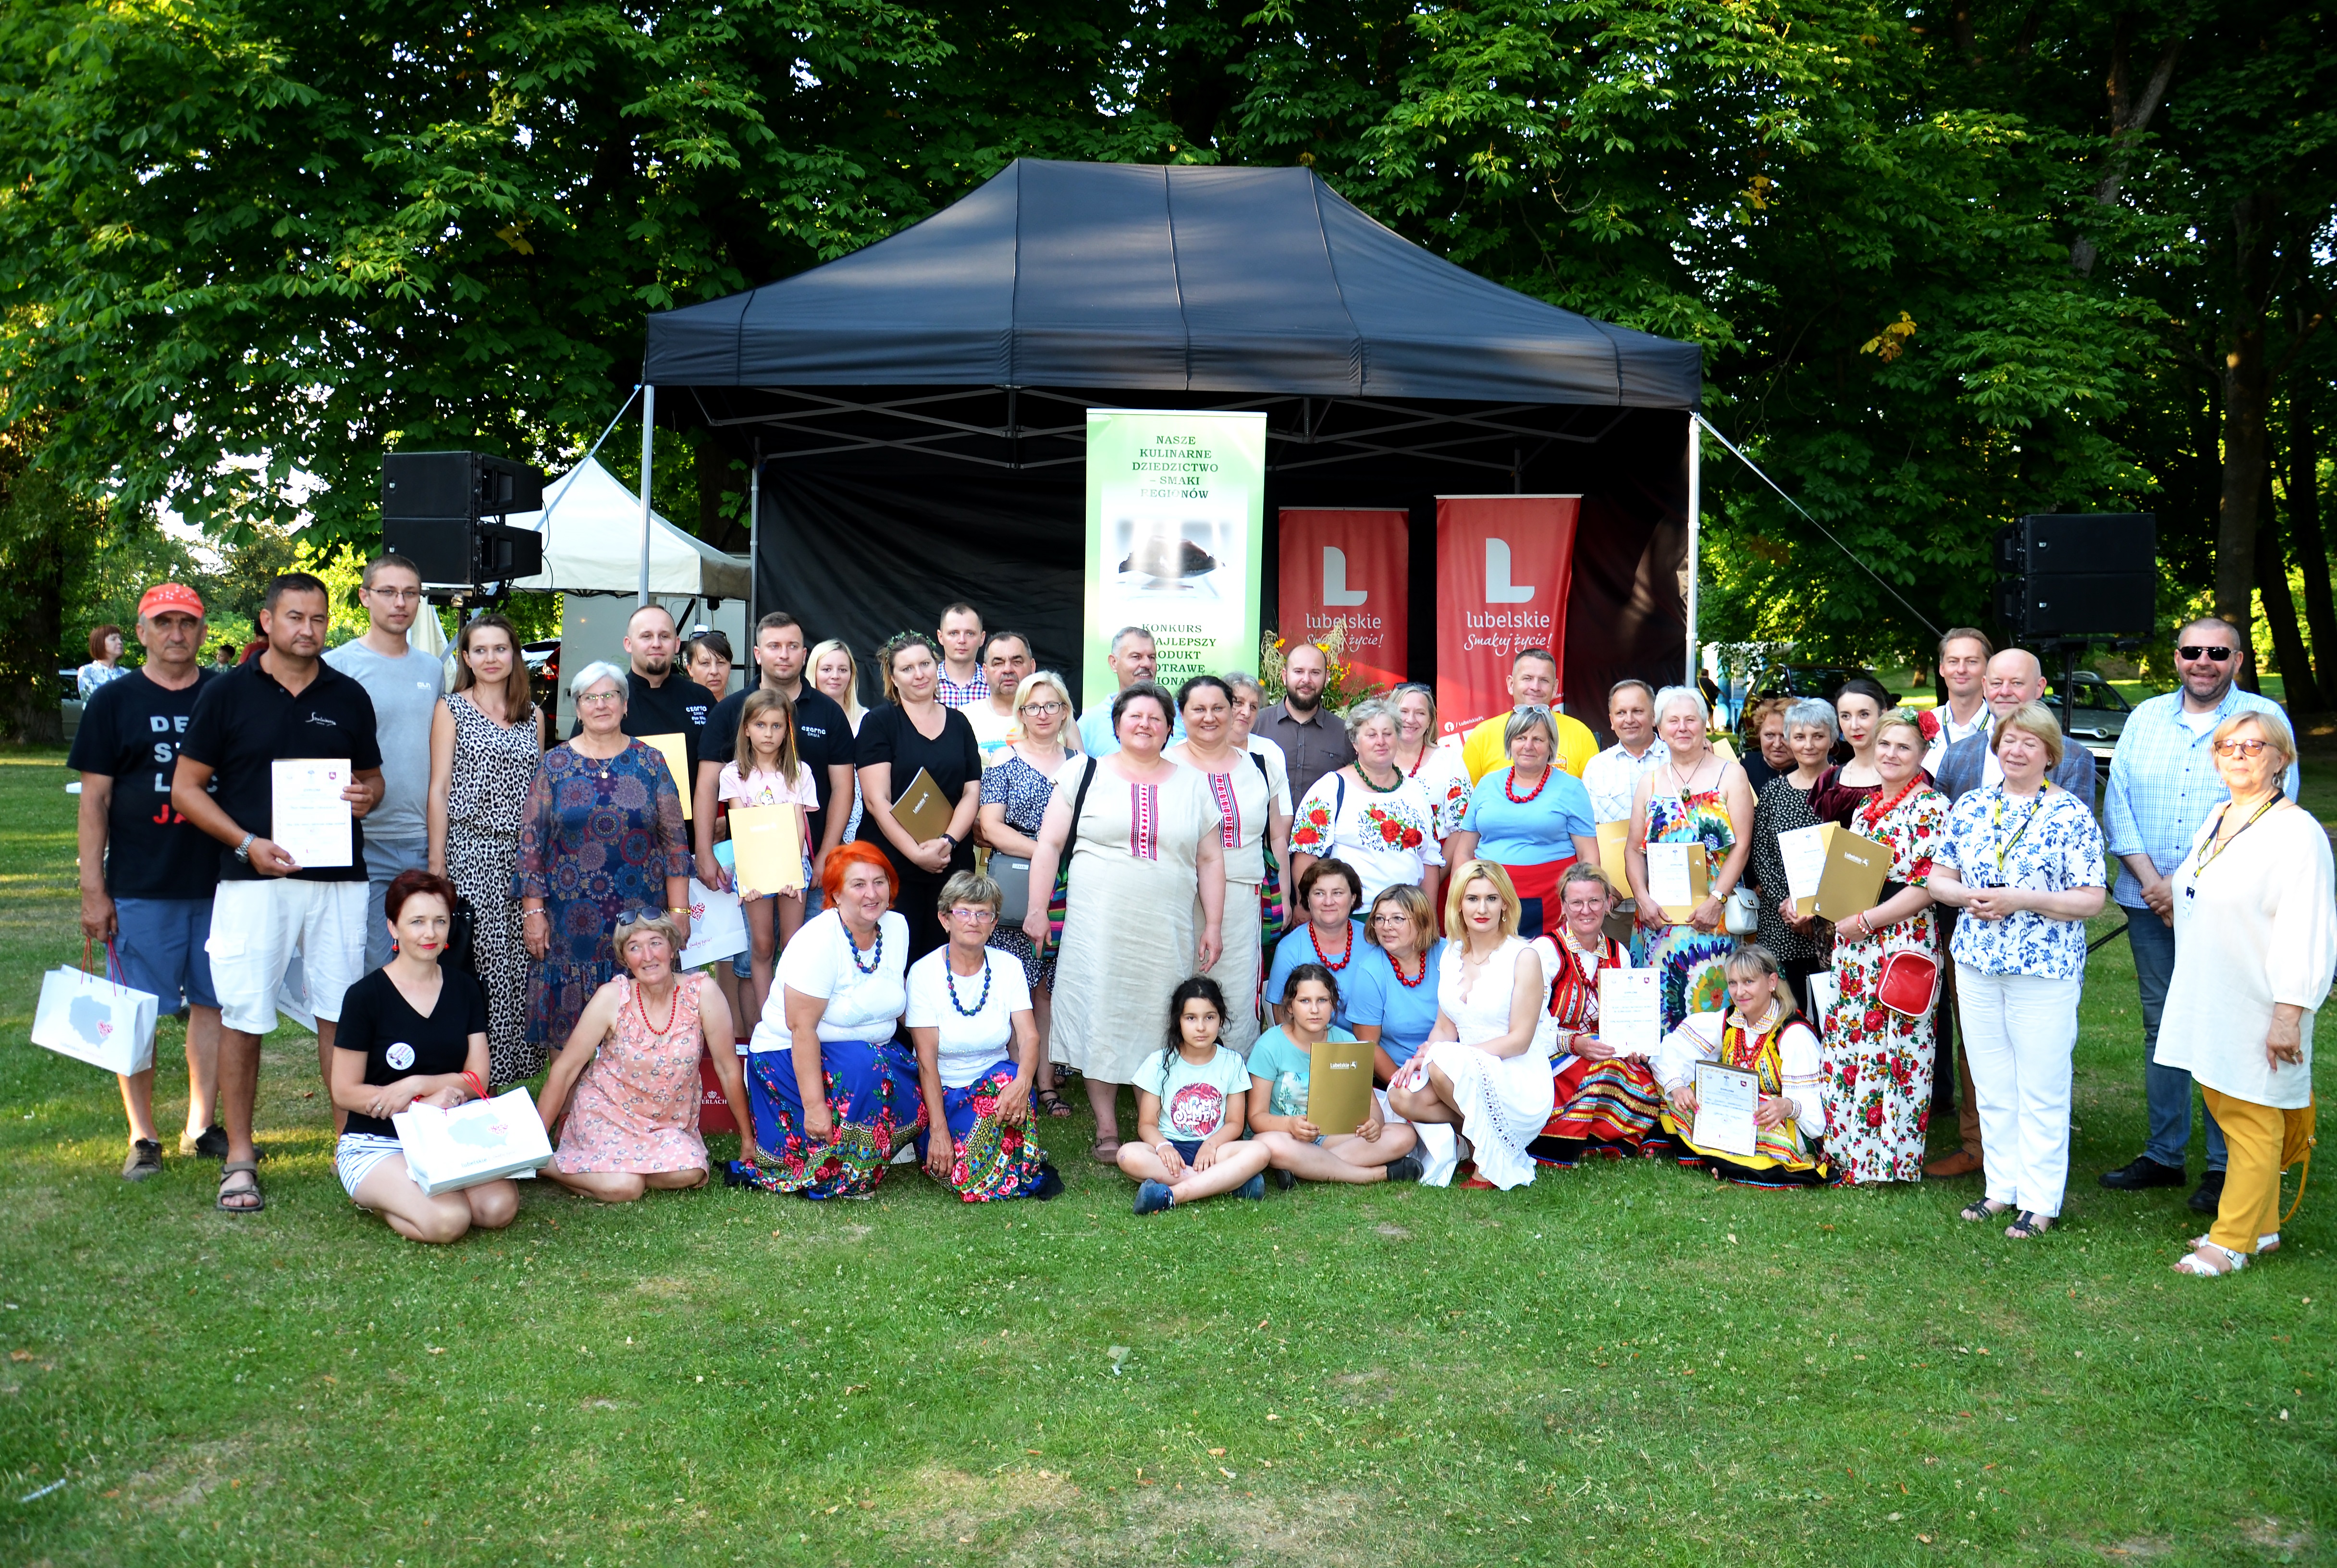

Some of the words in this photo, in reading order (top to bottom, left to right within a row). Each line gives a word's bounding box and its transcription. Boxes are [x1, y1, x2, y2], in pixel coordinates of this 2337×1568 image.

[1156, 436, 1196, 445] NASZE
[1139, 449, 1212, 458] KULINARNE
[1132, 462, 1219, 472] DZIEDZICTWO
[1160, 476, 1200, 485] SMAKI
[1140, 488, 1209, 499] REGIONÓW
[1306, 613, 1381, 629] lubelskie
[1466, 611, 1550, 628] lubelskie
[1142, 624, 1202, 633] KONKURS
[1154, 637, 1217, 647] AJLEPSZY
[1349, 634, 1384, 652] życie!
[1464, 632, 1513, 657] Smakuj
[1514, 633, 1552, 654] życie!
[1156, 651, 1201, 659] ODUKT
[1458, 716, 1484, 727] LubelskiePL
